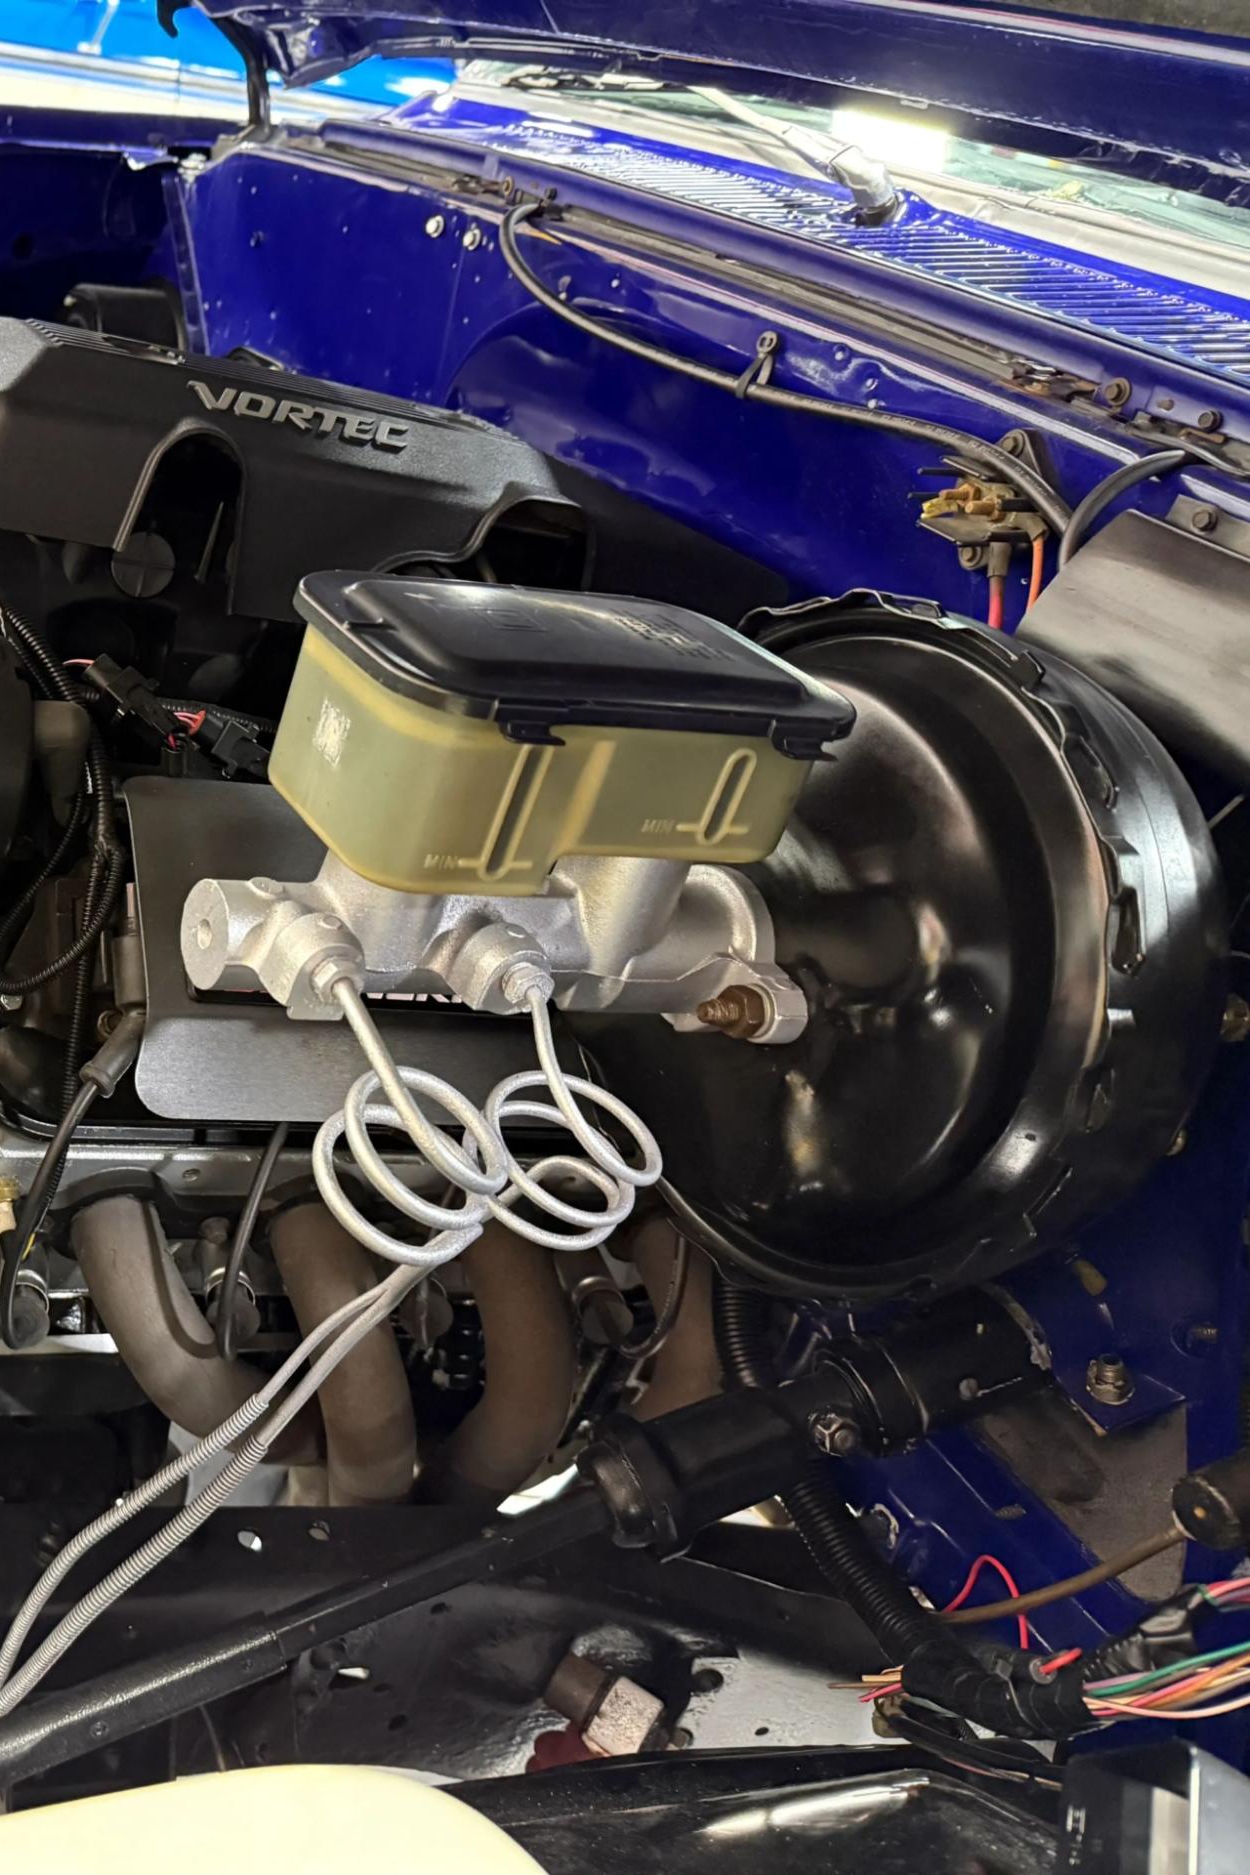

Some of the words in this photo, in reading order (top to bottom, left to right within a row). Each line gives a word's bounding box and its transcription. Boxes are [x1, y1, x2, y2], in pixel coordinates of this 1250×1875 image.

[186, 380, 408, 450] VORTEC
[640, 818, 676, 835] MIN
[423, 853, 460, 871] MIN
